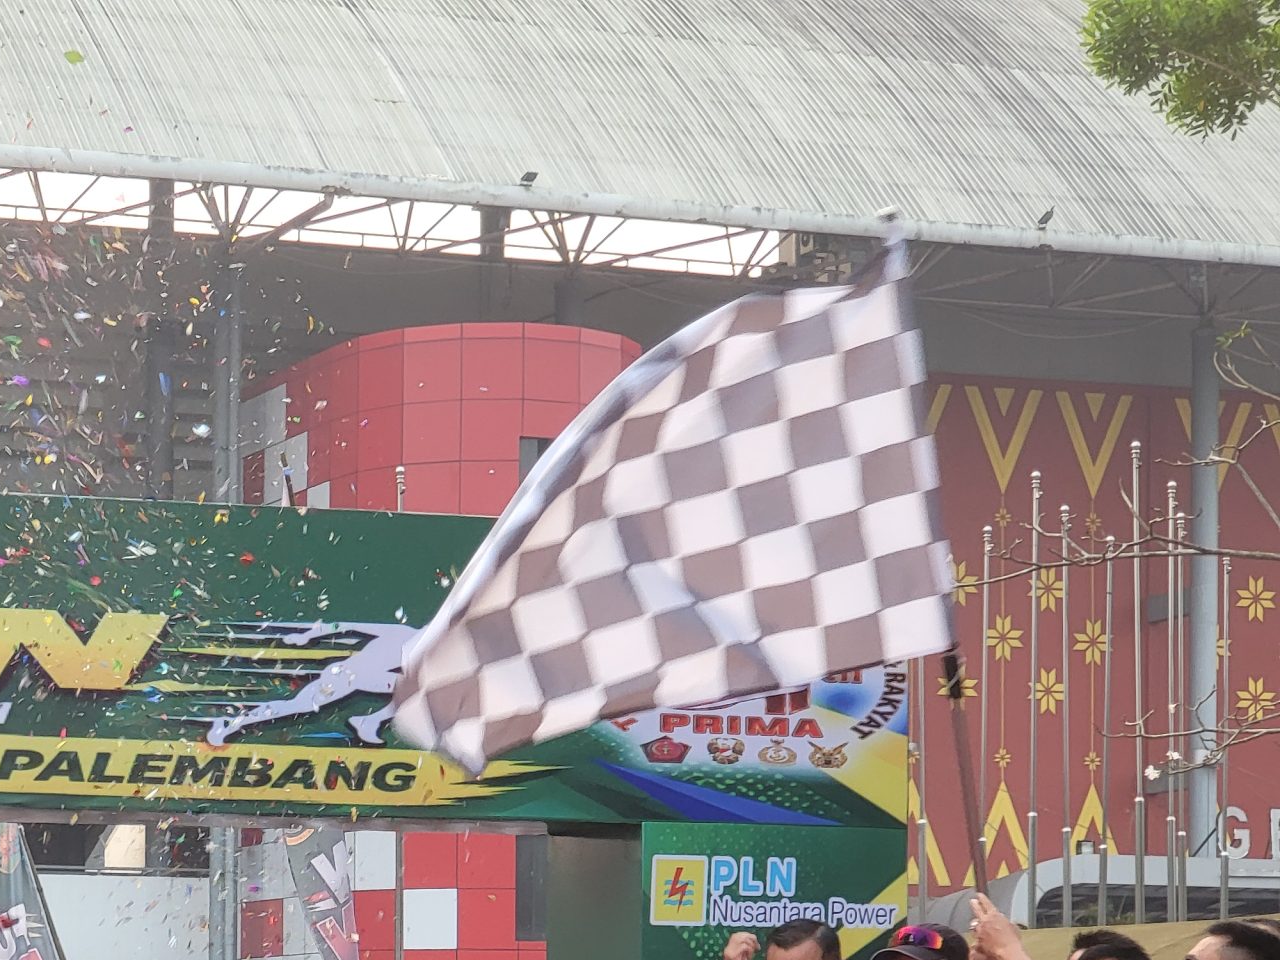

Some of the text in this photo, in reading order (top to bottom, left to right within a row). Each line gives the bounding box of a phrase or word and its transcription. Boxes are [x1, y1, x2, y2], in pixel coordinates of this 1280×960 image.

[849, 671, 907, 740] RAKYAT
[658, 711, 825, 740] PRIMA
[1217, 806, 1280, 860] G
[712, 858, 795, 894] PLN
[711, 897, 897, 927] Nusantara Power
